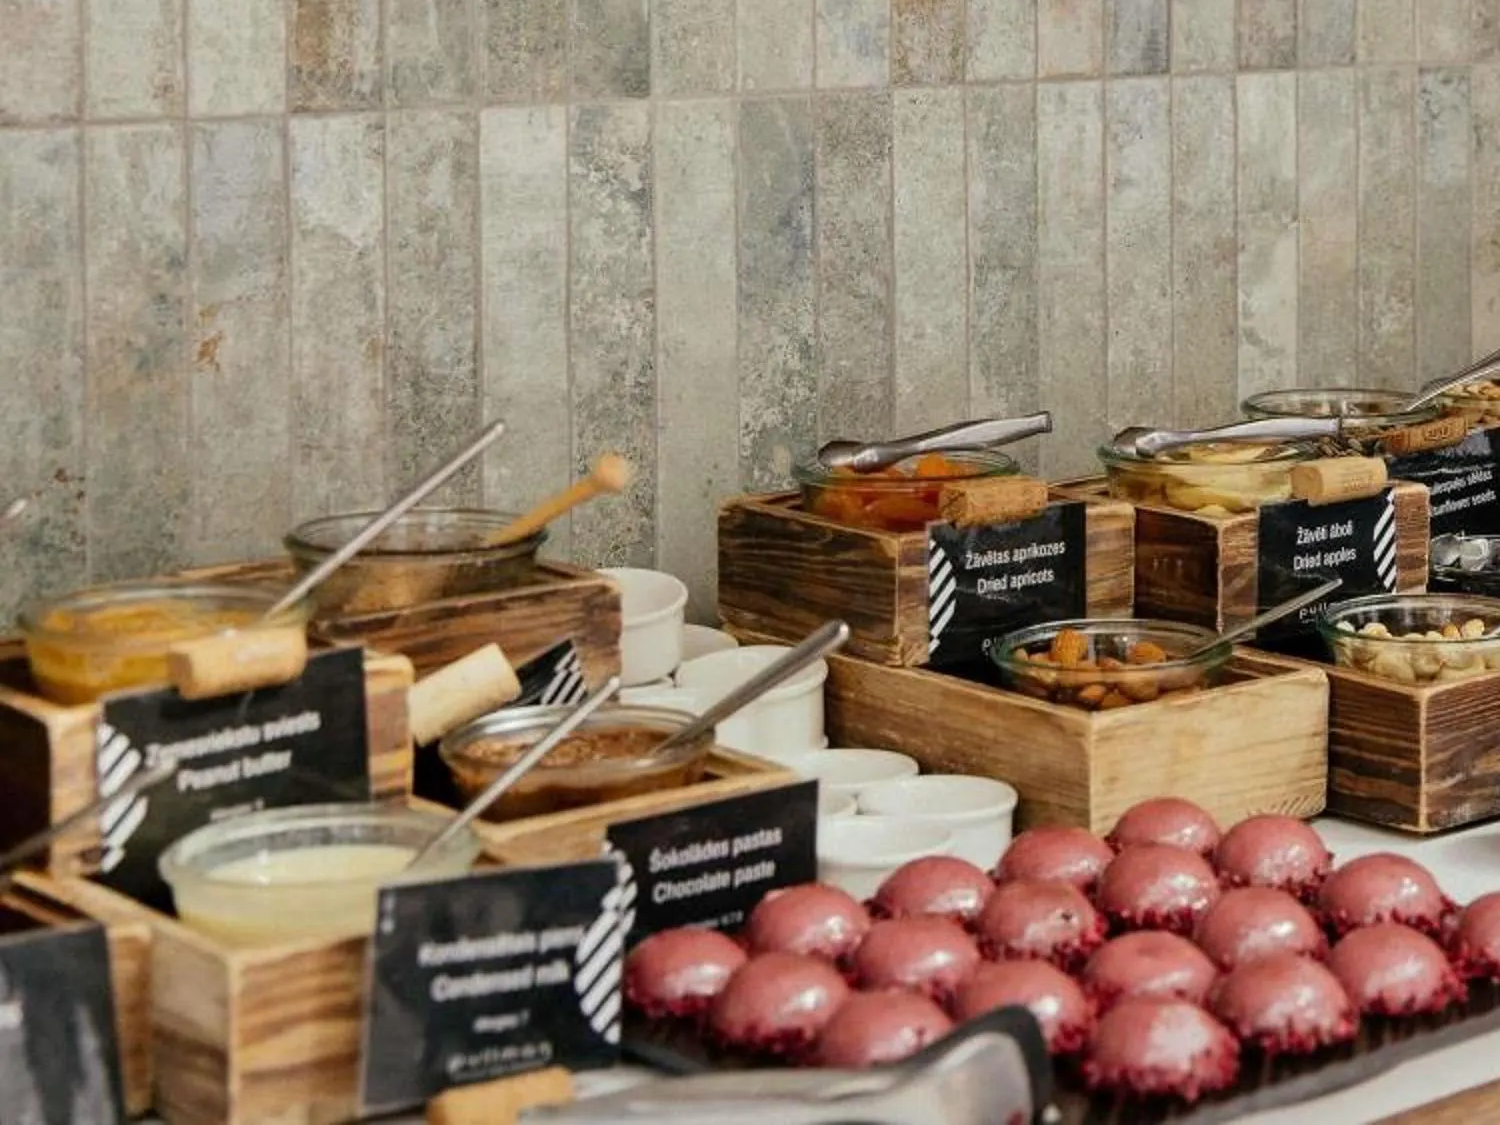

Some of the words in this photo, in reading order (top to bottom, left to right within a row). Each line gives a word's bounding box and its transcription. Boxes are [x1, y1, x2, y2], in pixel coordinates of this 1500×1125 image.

[1012, 539, 1067, 564] aprikozes
[1293, 551, 1322, 571] Dried
[1323, 546, 1357, 567] apples
[976, 574, 1008, 595] Dried
[1010, 567, 1056, 589] apricots
[652, 870, 731, 905] Chocolate
[734, 859, 777, 889] paste
